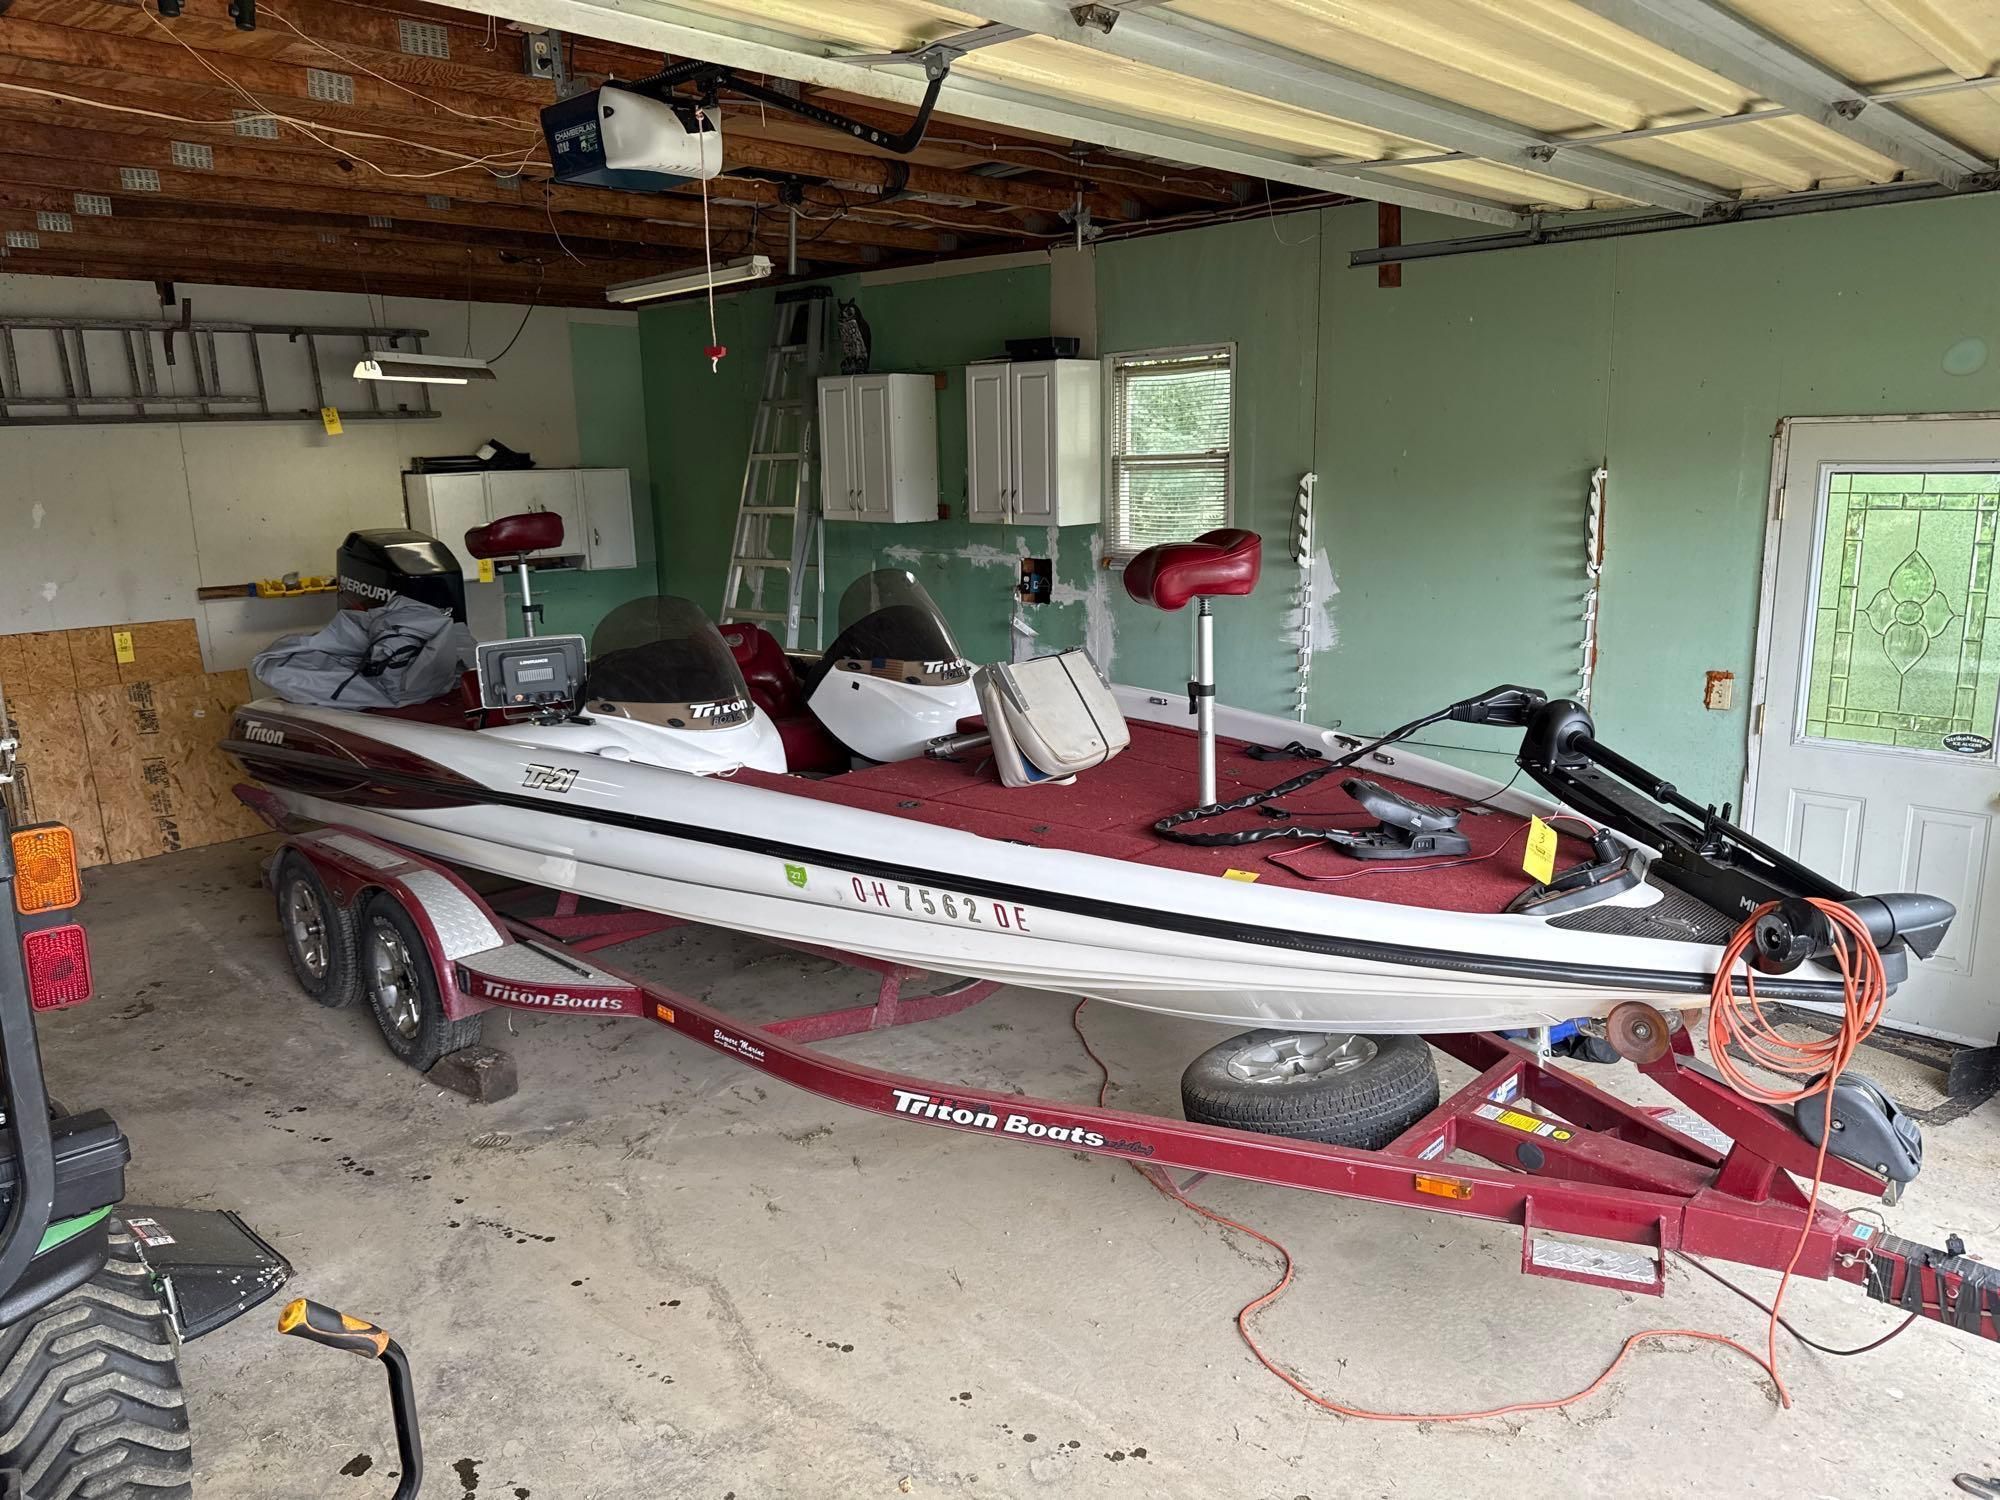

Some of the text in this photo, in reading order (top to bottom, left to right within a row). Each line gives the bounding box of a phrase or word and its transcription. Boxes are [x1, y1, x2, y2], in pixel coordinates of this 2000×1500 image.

[555, 121, 597, 141] CHAMBERLAIN
[340, 575, 397, 601] MERCURY
[690, 699, 748, 719] Triton
[245, 720, 284, 745] Triton
[852, 877, 1030, 932] OH 7562 DE
[483, 980, 623, 1009] Triton Boats
[740, 1040, 764, 1057] Marine
[892, 1089, 1104, 1147] Triton Boats
